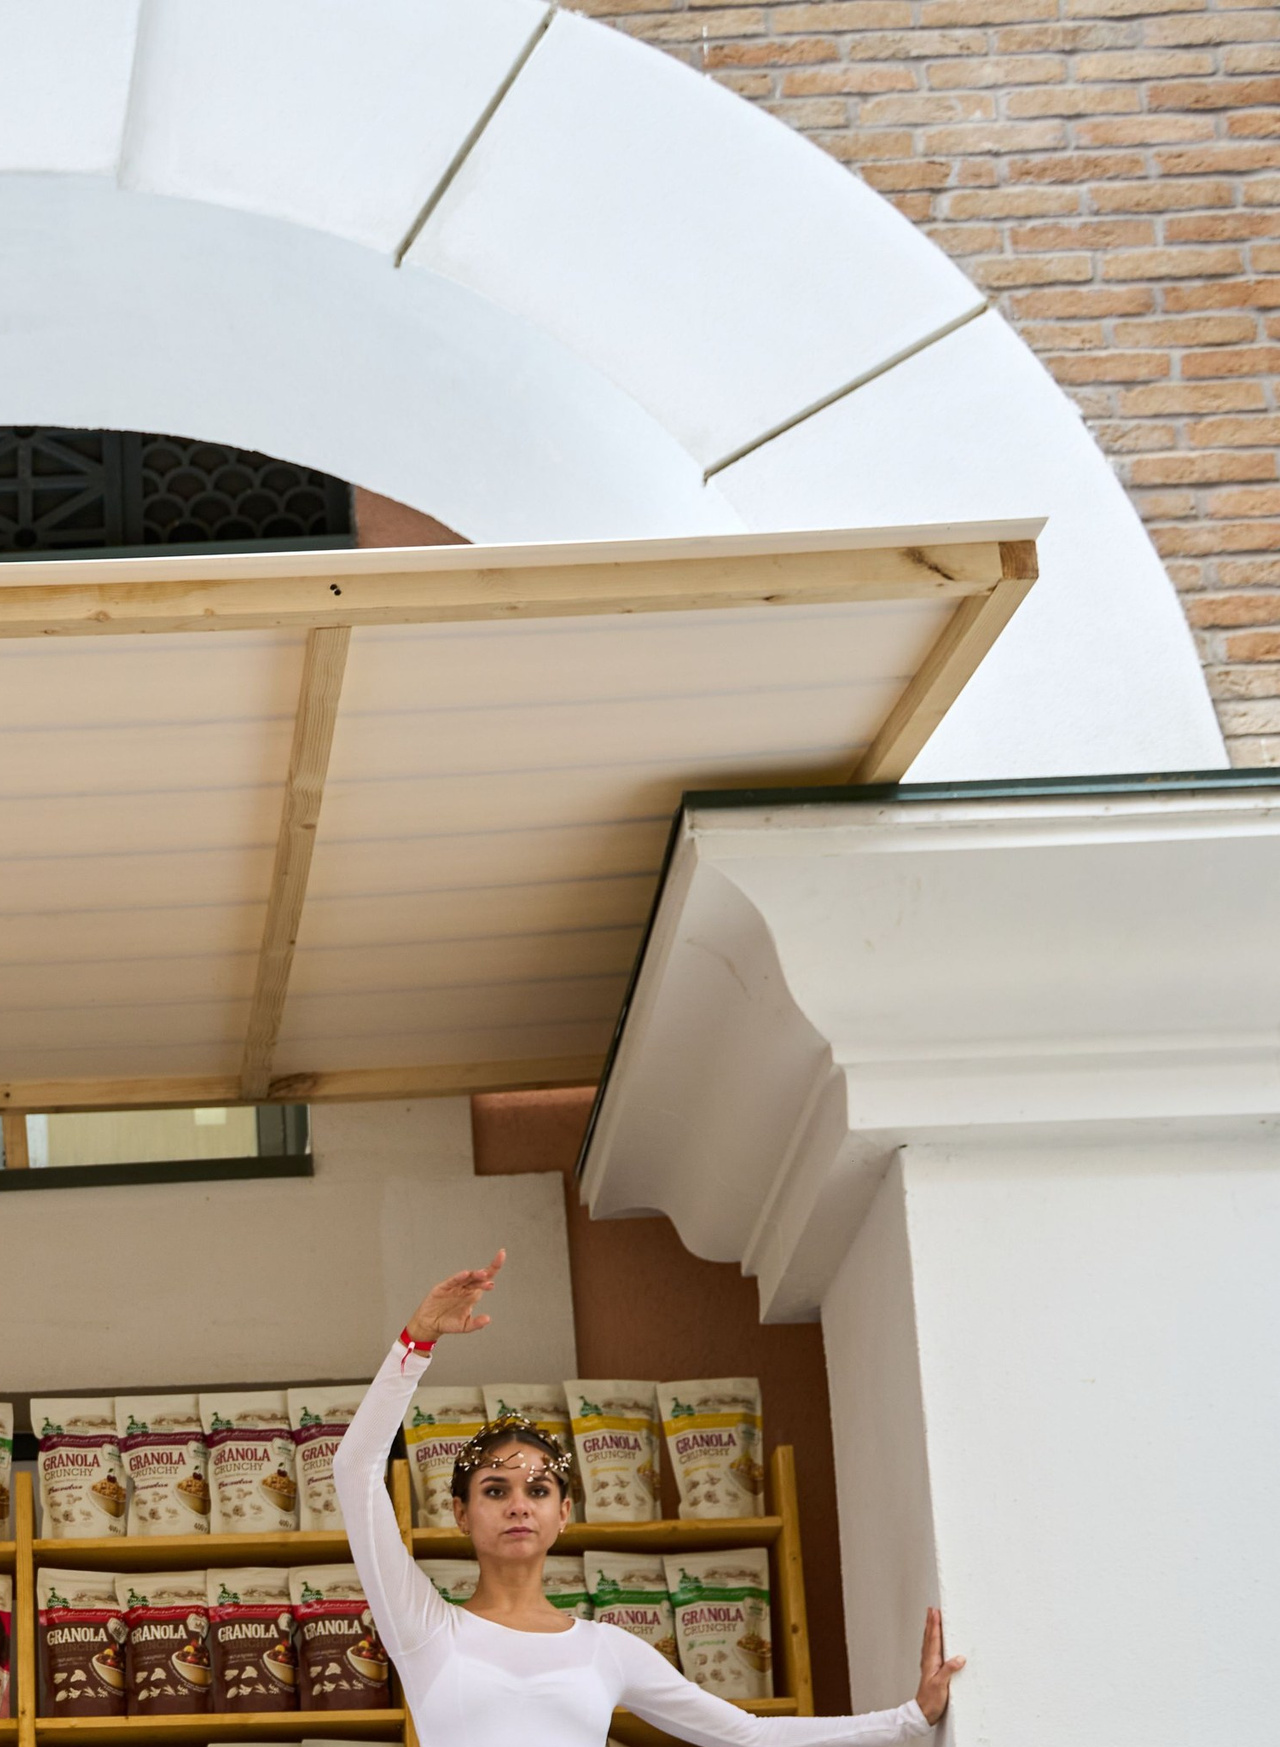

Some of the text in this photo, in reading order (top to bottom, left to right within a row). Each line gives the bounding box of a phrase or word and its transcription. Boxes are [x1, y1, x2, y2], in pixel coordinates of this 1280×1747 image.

[302, 1443, 339, 1461] GRANO
[416, 1443, 458, 1462] GRANO
[584, 1435, 641, 1452] GRANOLA
[676, 1433, 736, 1454] GRANOLA
[44, 1454, 100, 1471] GRANOLA
[129, 1452, 186, 1471] GRANOLA
[214, 1448, 270, 1466] GRANOLA
[586, 1451, 636, 1463] CRUNCHY
[679, 1449, 730, 1464] CRUNCHY
[44, 1469, 93, 1481] CRUNCHY
[214, 1463, 264, 1475] CRUNCHY
[600, 1611, 660, 1625] GRANOLA
[682, 1608, 744, 1626] GRANOLA
[47, 1628, 107, 1646] GRANOLA
[131, 1625, 187, 1645] GRANOLA
[218, 1624, 278, 1642] GRANOLA
[304, 1620, 362, 1640] GRANOLA
[684, 1624, 737, 1636] CRUNCHY
